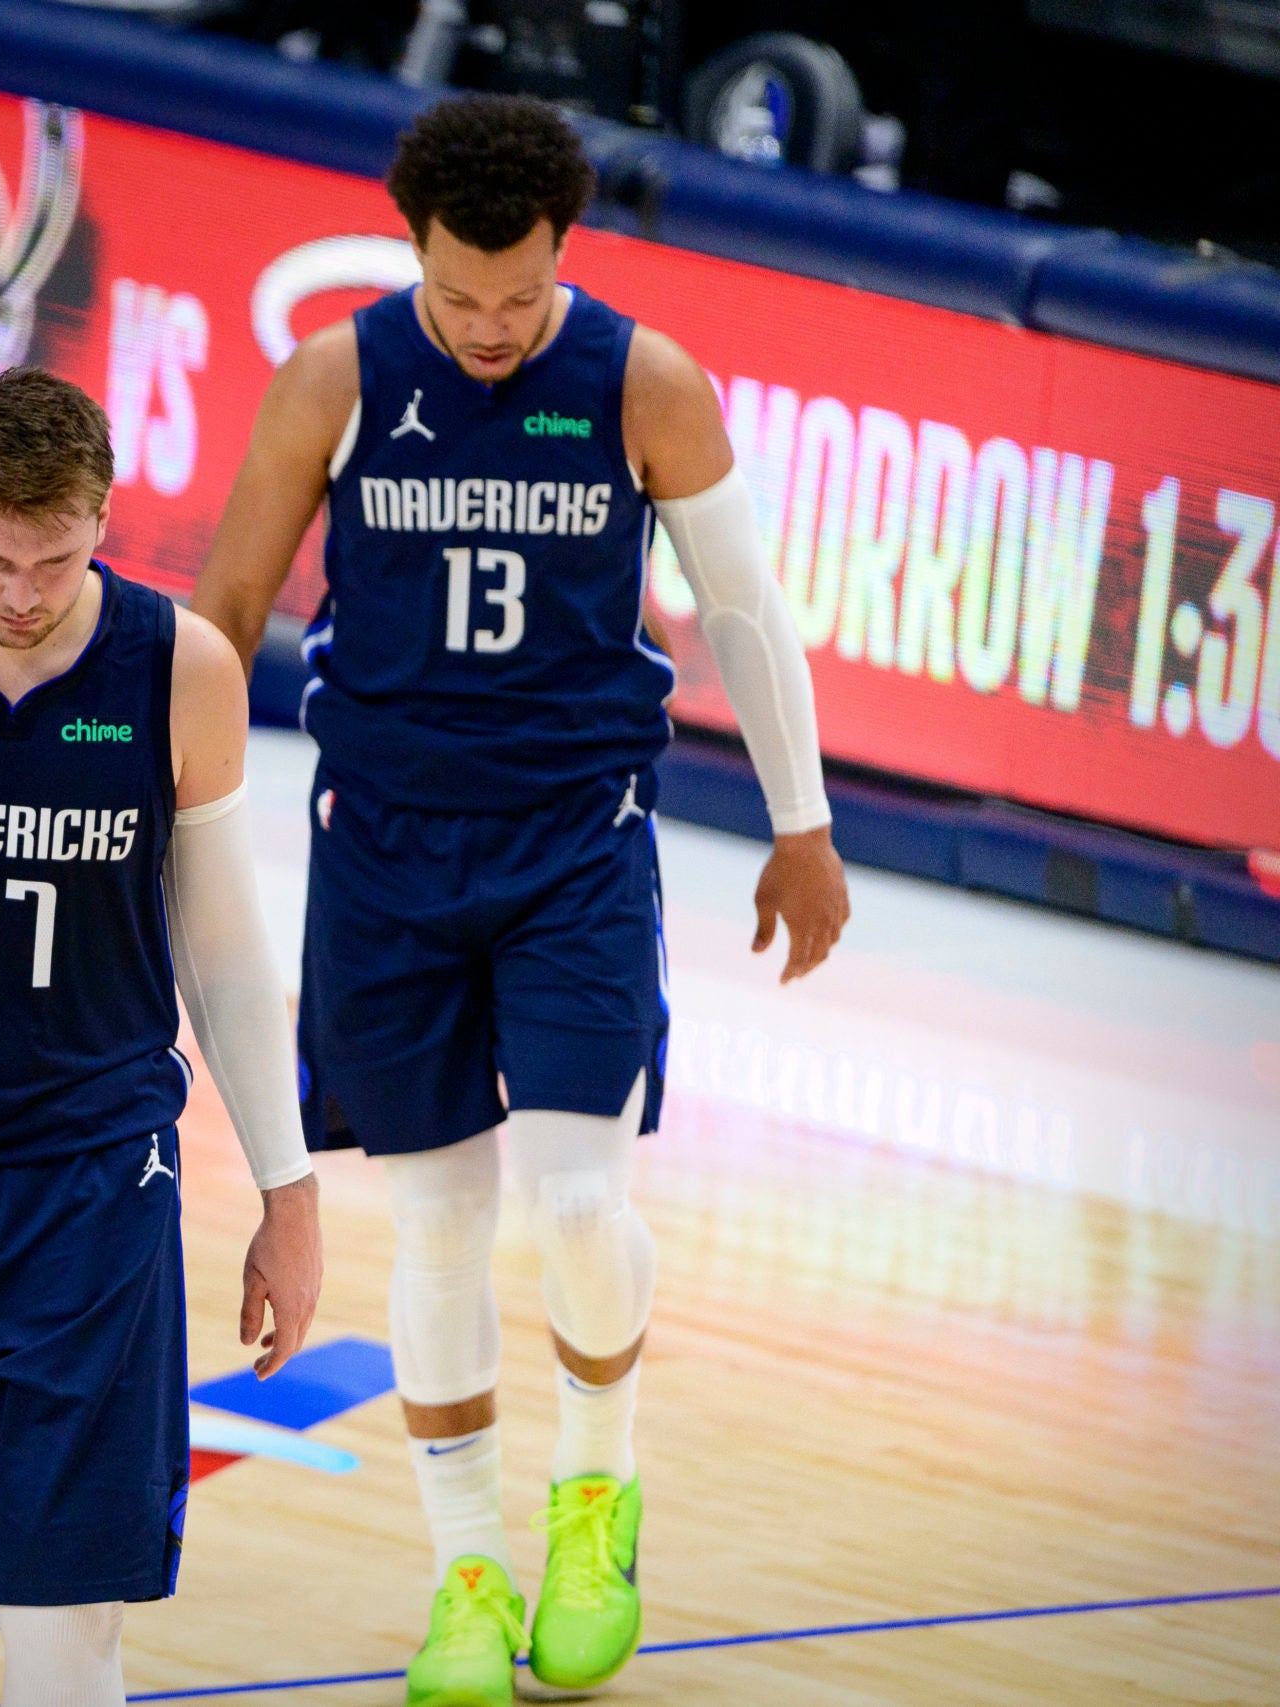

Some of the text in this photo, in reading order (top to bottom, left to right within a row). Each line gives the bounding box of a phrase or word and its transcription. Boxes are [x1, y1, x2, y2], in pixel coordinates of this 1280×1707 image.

[108, 277, 210, 497] VS
[524, 411, 592, 438] chime
[360, 476, 612, 536] MAVERICKS
[443, 547, 526, 653] 13
[61, 718, 133, 742] chime
